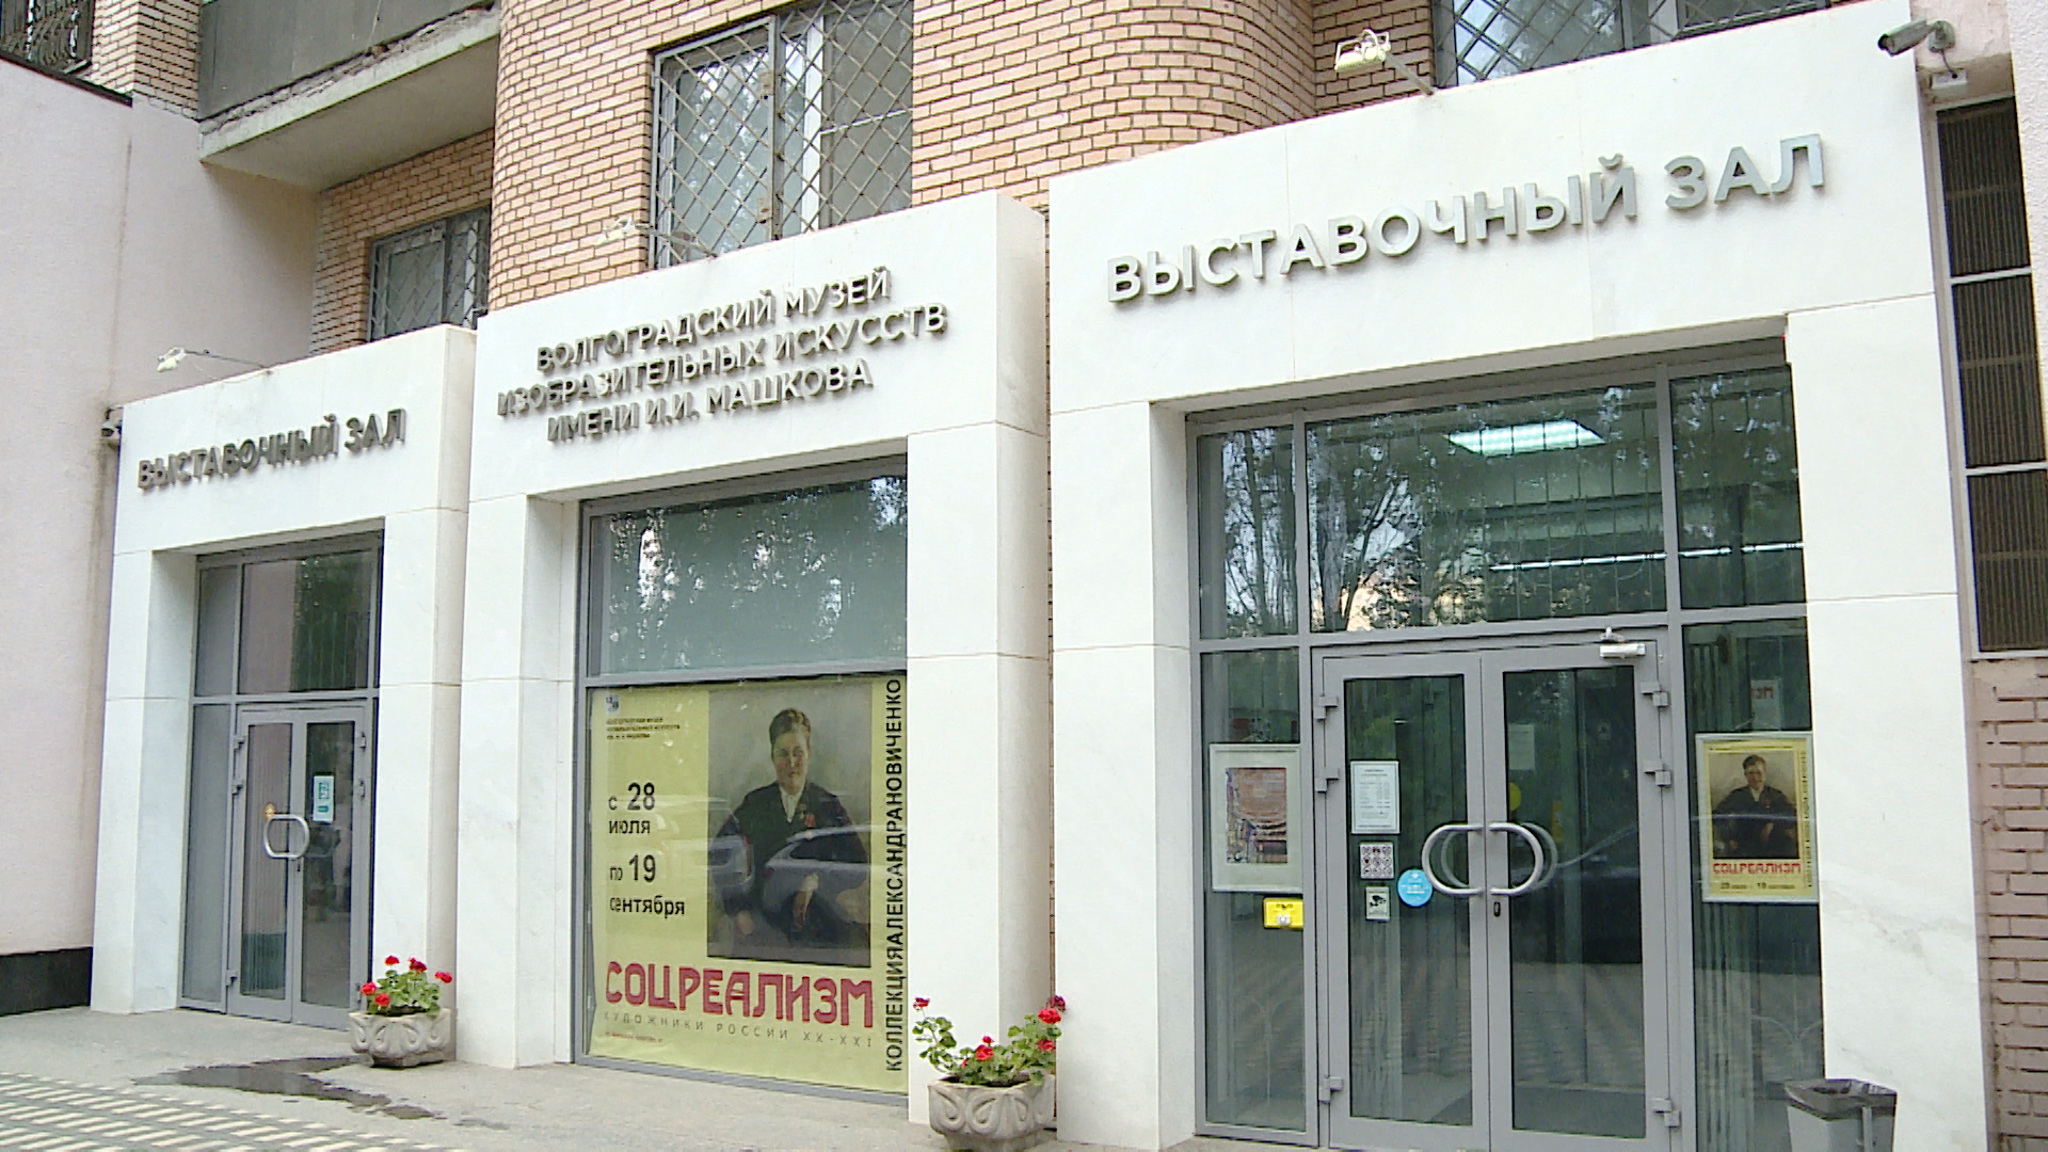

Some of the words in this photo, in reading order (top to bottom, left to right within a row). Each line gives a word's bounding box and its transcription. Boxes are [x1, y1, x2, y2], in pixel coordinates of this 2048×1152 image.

[1107, 153, 1637, 302] ВЫСТАВОЧНЫЙ
[1664, 133, 1825, 209] ЗАЛ
[537, 289, 776, 373] ВОЛГОГРАДСКИЙ
[783, 266, 892, 318] МУЗЕЙ
[497, 337, 766, 417] ИЗОБРАЗИТЕЛЬНЫХ
[774, 302, 948, 360] ИСКУССТВ
[547, 401, 639, 442] ИМЕНИ
[645, 391, 699, 425] И.И.
[706, 358, 874, 414] МАШКОВА
[138, 413, 339, 489] ВЫСТАВОЧНЫЙ
[344, 408, 406, 452] ЗАЛ
[609, 820, 650, 834] июля
[627, 782, 655, 811] 28
[629, 855, 656, 882] 19
[610, 895, 685, 919] сентября
[606, 961, 873, 1028] СОЦРЕАЛИЗМ
[716, 1023, 788, 1039] РОССИИ
